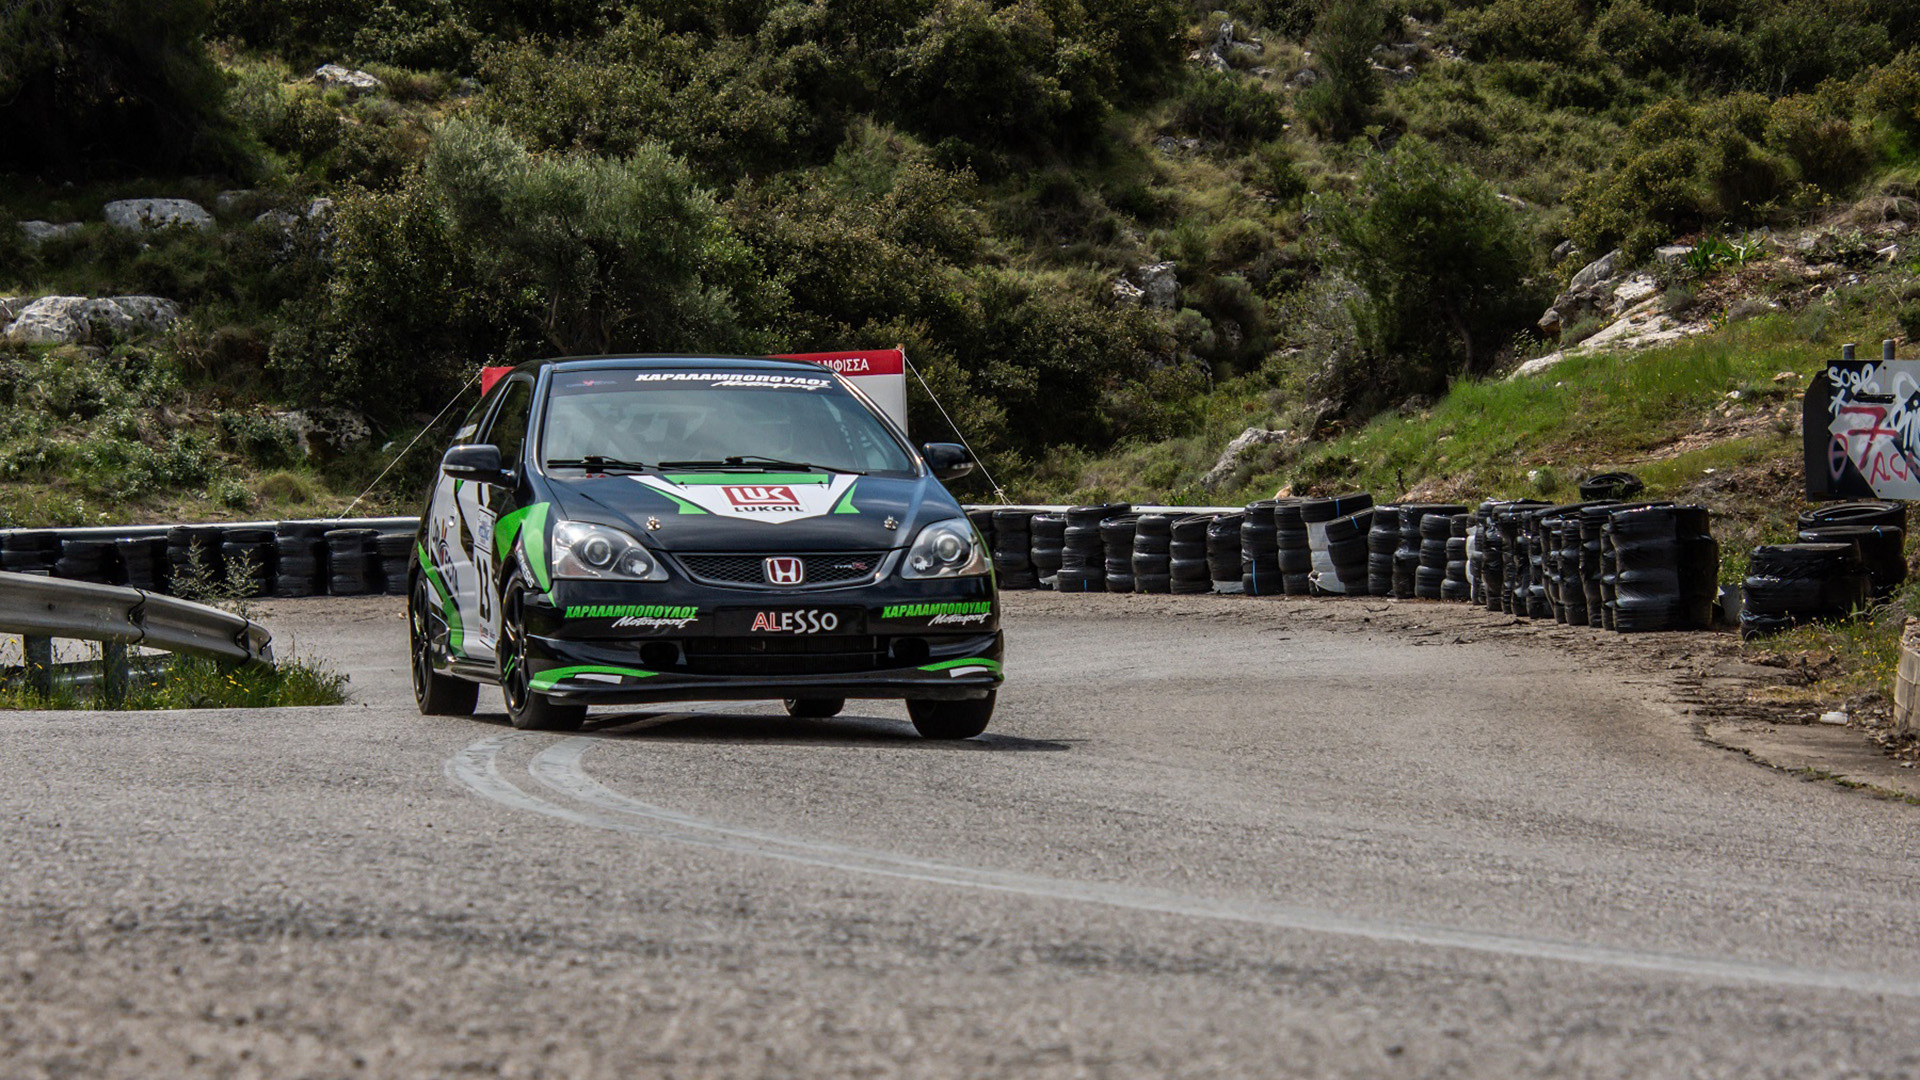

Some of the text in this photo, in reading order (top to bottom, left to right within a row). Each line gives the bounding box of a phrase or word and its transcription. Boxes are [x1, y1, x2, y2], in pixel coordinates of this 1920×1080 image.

[564, 606, 699, 618] ΧΑΡΑΛΑΜΠΟΠΟΥΛΟΣ
[882, 601, 991, 618] ΧΑΡΑΛΑΜΠΟΠΟΥΛΟΣ
[612, 616, 698, 628] Motorsport
[751, 609, 838, 634] ALESSO
[928, 613, 991, 626] Motorsport
